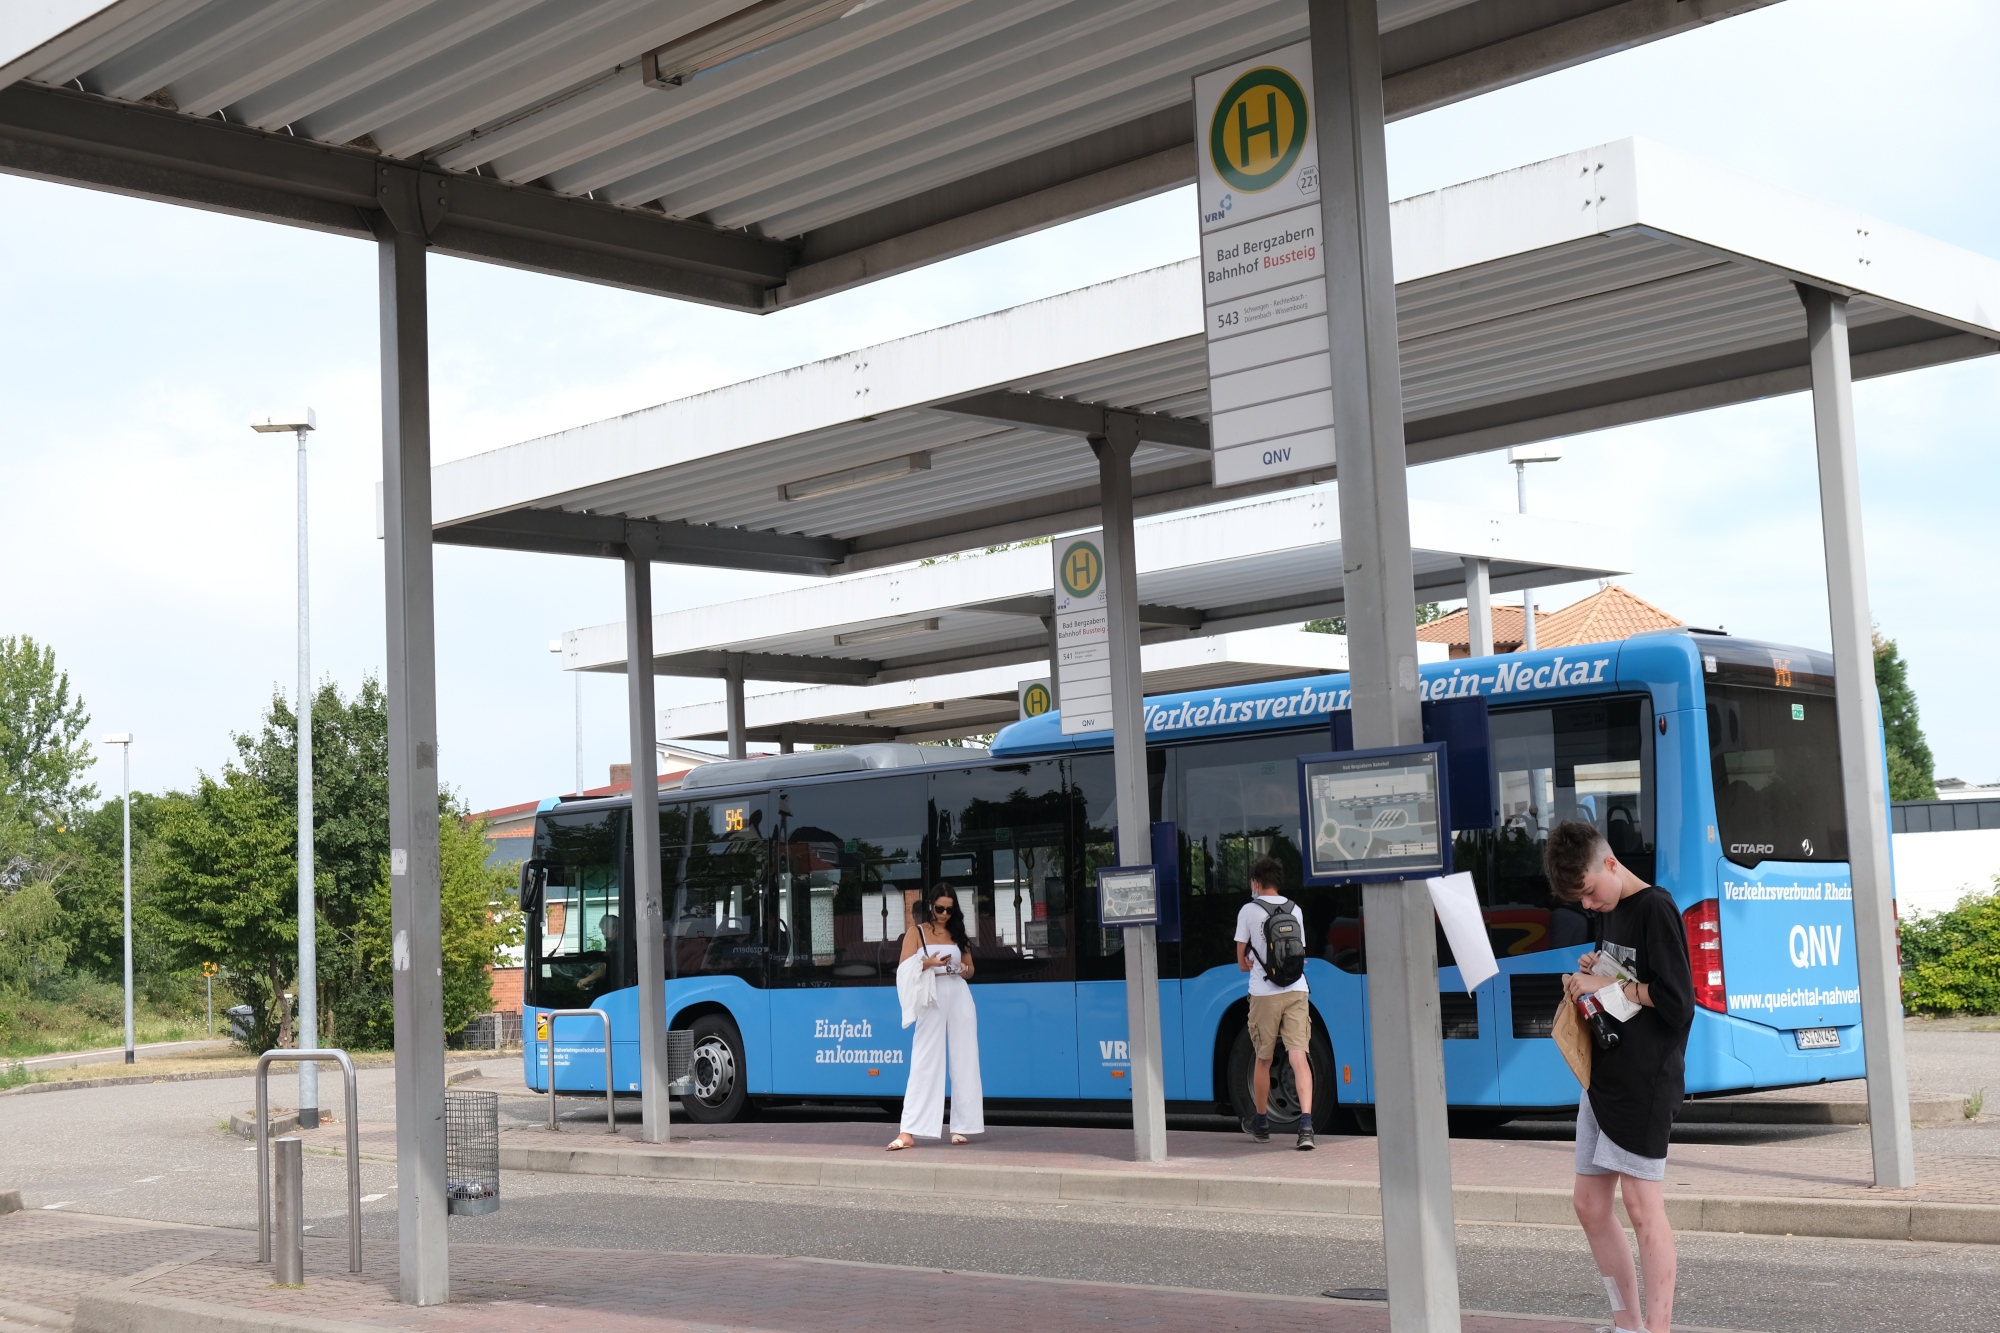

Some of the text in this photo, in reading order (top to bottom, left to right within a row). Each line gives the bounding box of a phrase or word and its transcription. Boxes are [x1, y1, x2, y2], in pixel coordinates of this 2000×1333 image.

[1300, 174, 1318, 189] 221
[1204, 210, 1225, 224] VRN
[1217, 227, 1315, 263] Bad Bergzabern
[1208, 245, 1316, 284] Bahnhof Bussteig
[1243, 303, 1269, 315] Schweigen
[1273, 293, 1304, 307] Rechtenbach
[1244, 310, 1272, 323] Dörrenbach
[1275, 302, 1308, 315] Wissembourg
[1218, 311, 1240, 329] 543
[1262, 447, 1292, 466] QNV
[1058, 628, 1082, 639] Bahnhof
[1082, 626, 1106, 636] Bussteig
[1062, 617, 1106, 629] Bad Bergzabern
[1063, 652, 1073, 661] 541
[1143, 656, 1610, 732] Verkehrsverbun hein-Neckar
[1081, 718, 1095, 727] QNV
[725, 808, 743, 832] 545
[1730, 843, 1774, 855] CITARO
[1724, 881, 1822, 901] Verkehrsverbund
[1789, 924, 1842, 969] QNV
[814, 1019, 872, 1042] Einfach
[1799, 1029, 1838, 1044] PS QN 415
[815, 1044, 903, 1065] ankommen
